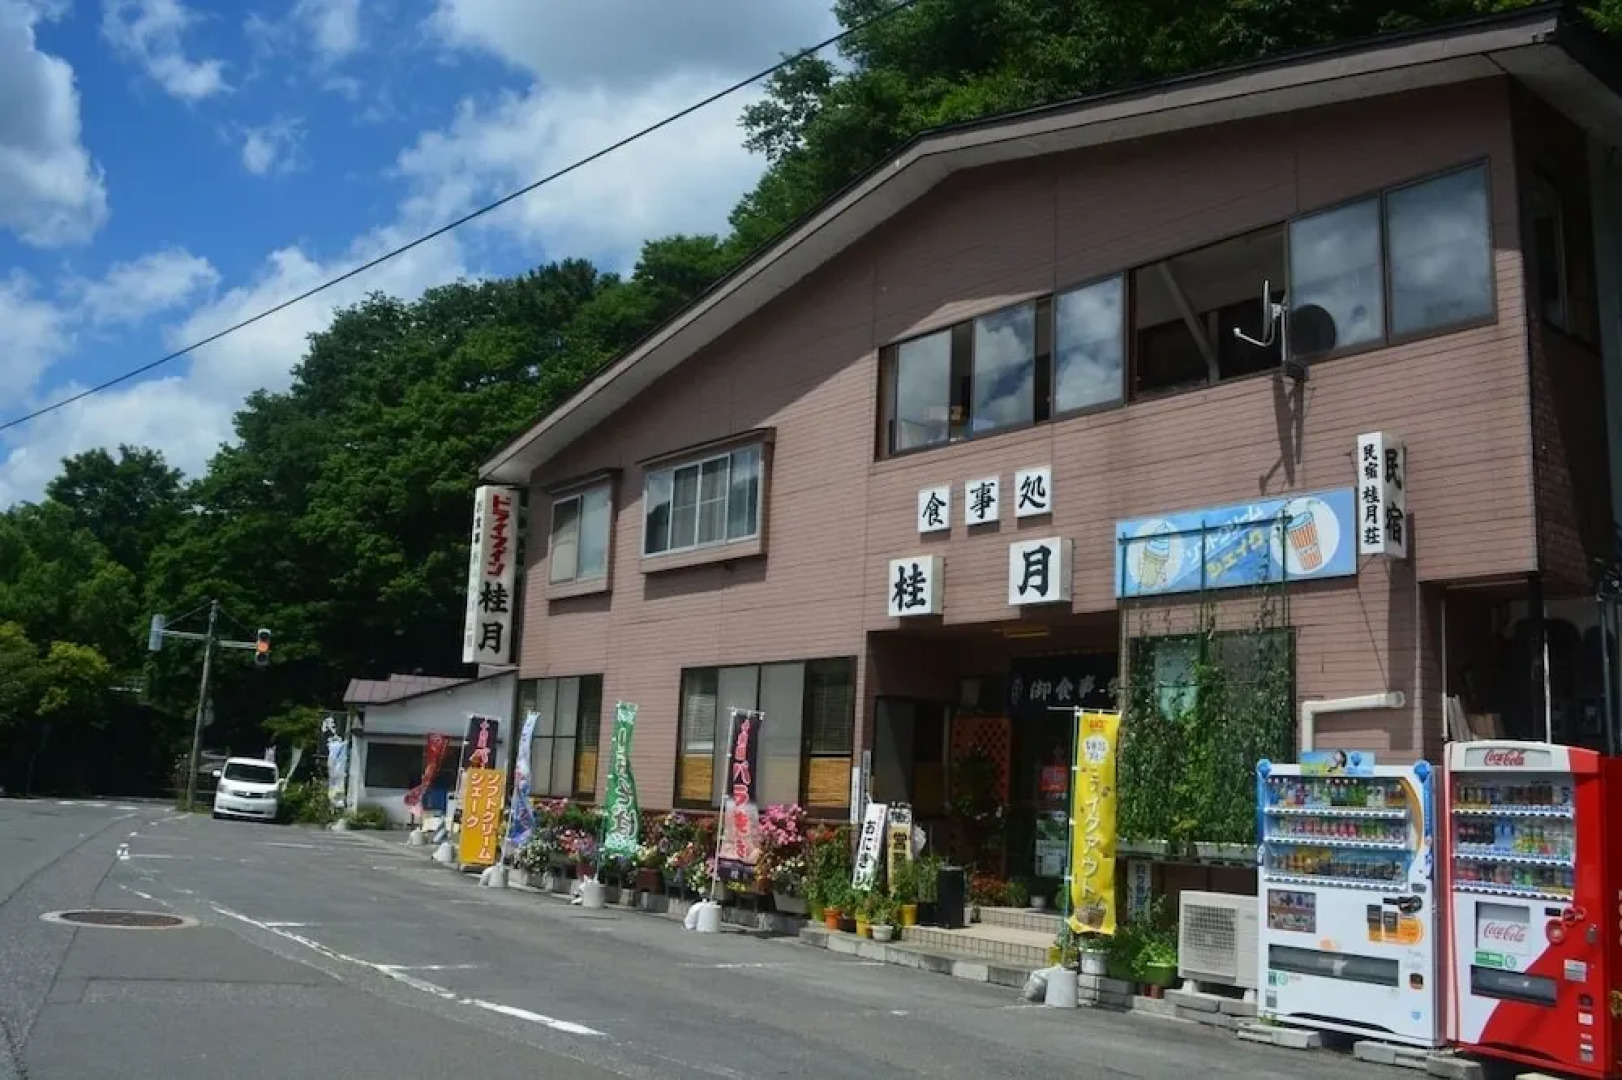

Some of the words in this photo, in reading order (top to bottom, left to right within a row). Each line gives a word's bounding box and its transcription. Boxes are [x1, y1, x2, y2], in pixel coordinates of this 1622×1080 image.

[1362, 443, 1380, 480] 民宿
[922, 474, 1047, 527] 食事処
[1362, 485, 1382, 545] 桂月荘
[1384, 448, 1405, 547] 民宿
[892, 545, 1053, 611] 桂月
[478, 581, 510, 654] 桂月
[1484, 749, 1526, 766] Coca-Cola
[478, 773, 500, 859] ソフトクリーム
[1483, 922, 1526, 943] Coca-Cola
